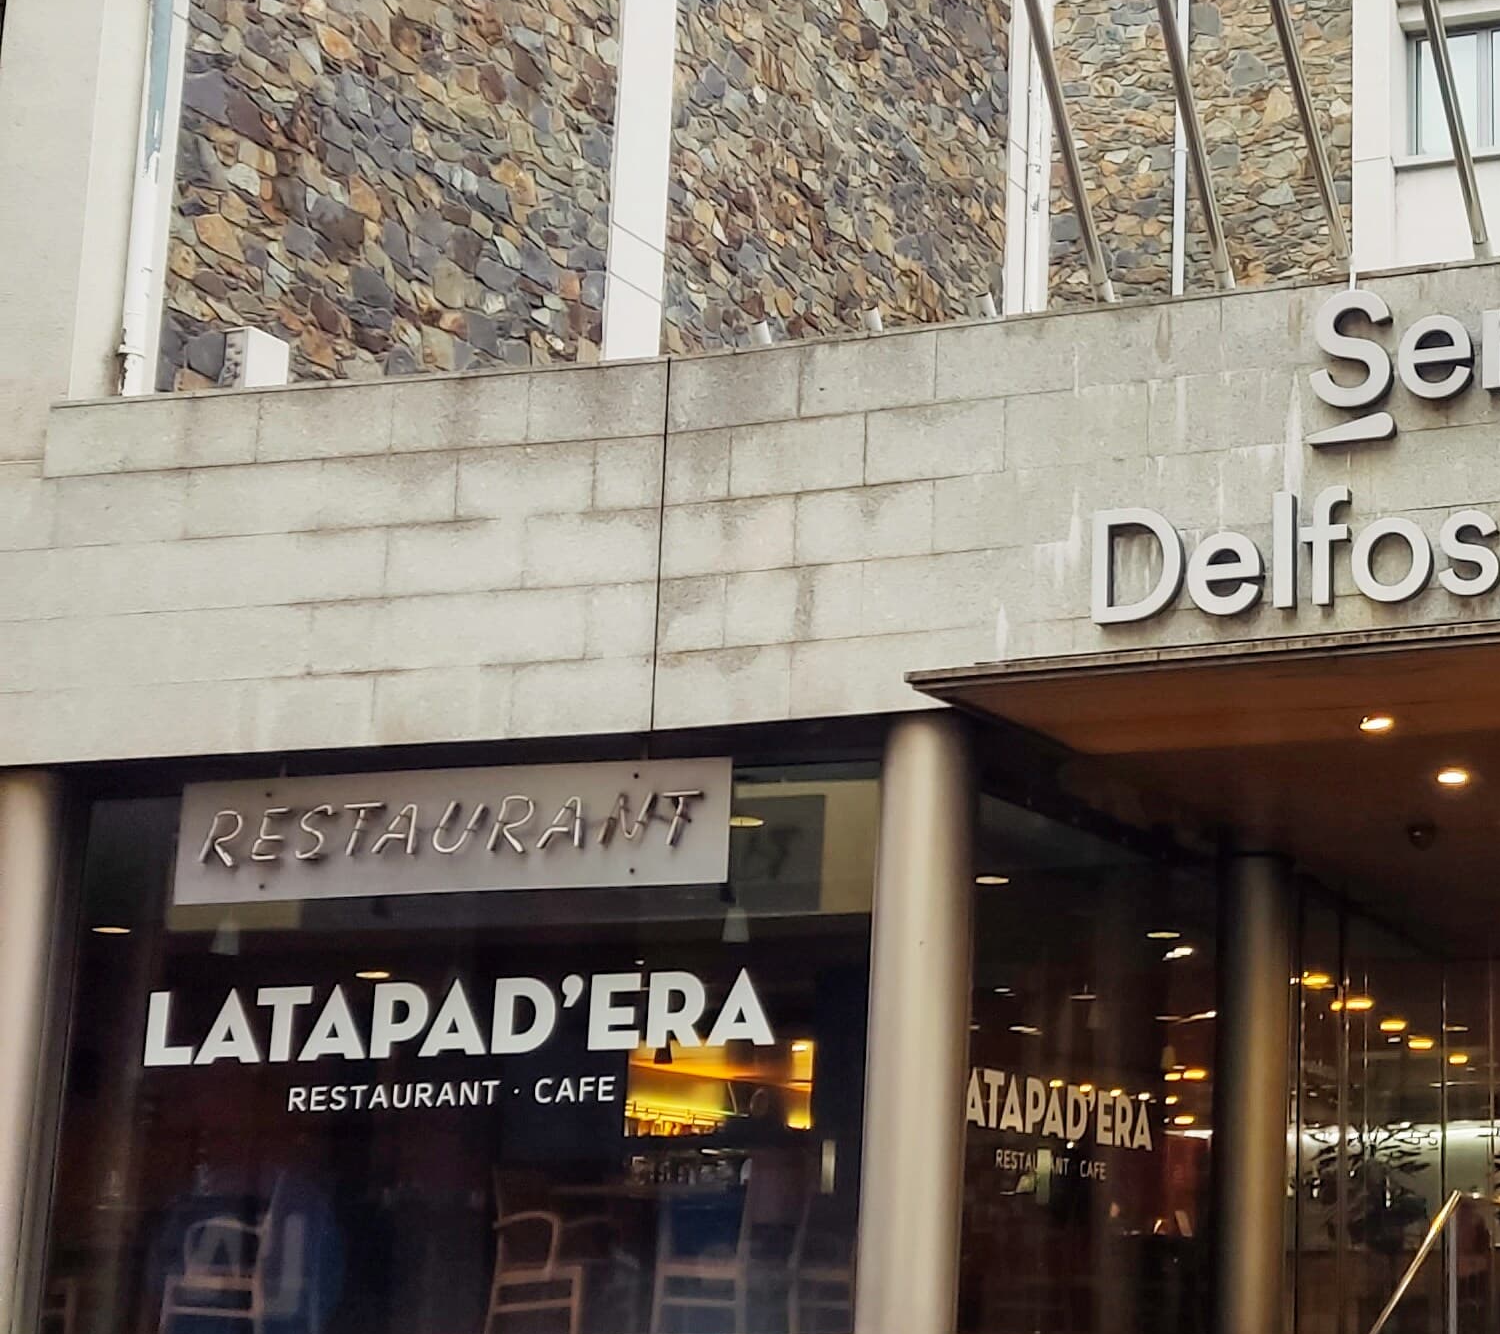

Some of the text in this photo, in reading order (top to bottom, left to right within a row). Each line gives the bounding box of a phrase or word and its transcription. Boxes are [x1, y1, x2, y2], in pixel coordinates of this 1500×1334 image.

[1092, 483, 1500, 626] Delfos
[198, 789, 703, 868] RESTAURANT
[143, 967, 776, 1067] LATAPAD'ERA
[287, 1076, 616, 1113] RESTAURANT CAFE
[966, 1066, 1153, 1152] ATAPAD'ERA
[1079, 1160, 1107, 1180] CAFE
